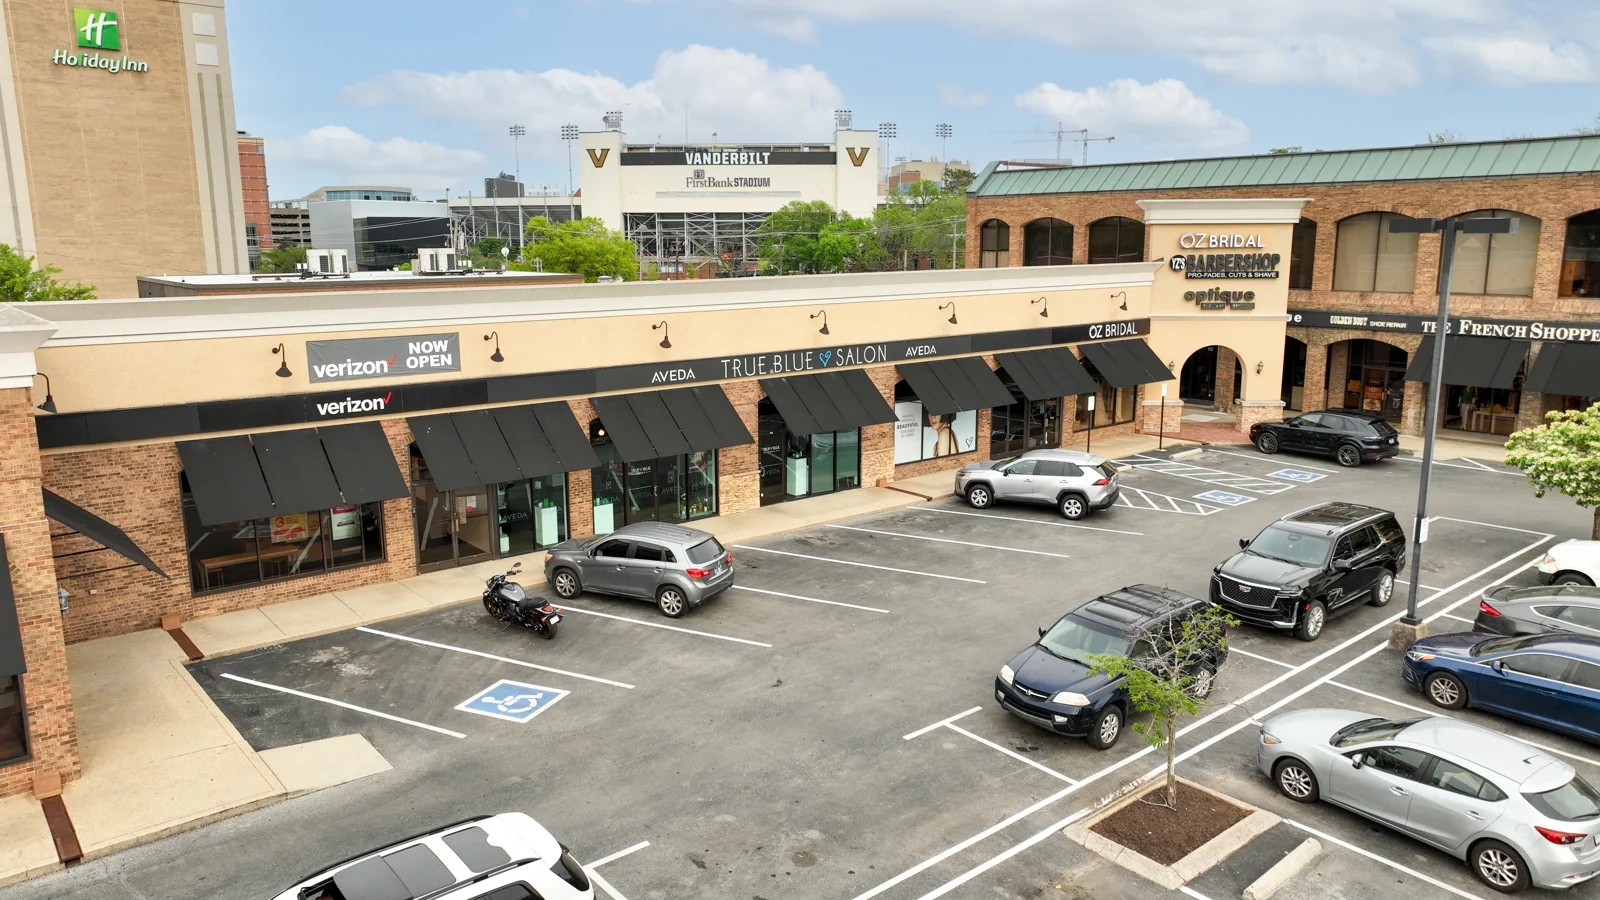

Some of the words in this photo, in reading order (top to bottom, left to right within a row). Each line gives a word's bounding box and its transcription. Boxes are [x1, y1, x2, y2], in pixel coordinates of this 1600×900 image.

[53, 48, 121, 73] Holiday
[122, 56, 148, 72] Inn
[586, 148, 610, 168] V
[685, 152, 770, 165] VANDERBILT
[846, 147, 870, 167] V
[686, 176, 733, 188] FirstBank
[734, 177, 770, 188] STADIUM
[1179, 232, 1208, 249] OZ
[1209, 234, 1265, 248] BRIDAL
[1171, 257, 1186, 270] YZ'S
[1186, 253, 1281, 271] BARBERSHOP
[1183, 287, 1256, 305] optique
[1330, 315, 1353, 325] GOLDEN
[1353, 316, 1368, 326] BOOT
[1089, 325, 1103, 339] OZ
[1105, 321, 1138, 337] BRIDAL
[1458, 319, 1527, 338] FRENCH
[1530, 322, 1600, 342] SHOPPE
[408, 340, 449, 355] NOW
[313, 358, 388, 378] verizon
[406, 353, 453, 369] OPEN
[651, 367, 696, 384] AVEDA
[721, 355, 766, 379] TRUE
[773, 351, 814, 374] BLUE
[836, 344, 887, 367] SALON
[905, 345, 937, 357] AVEDA
[316, 397, 385, 416] verizon
[896, 422, 919, 430] BEAUTIFUL
[275, 516, 285, 528] 3
